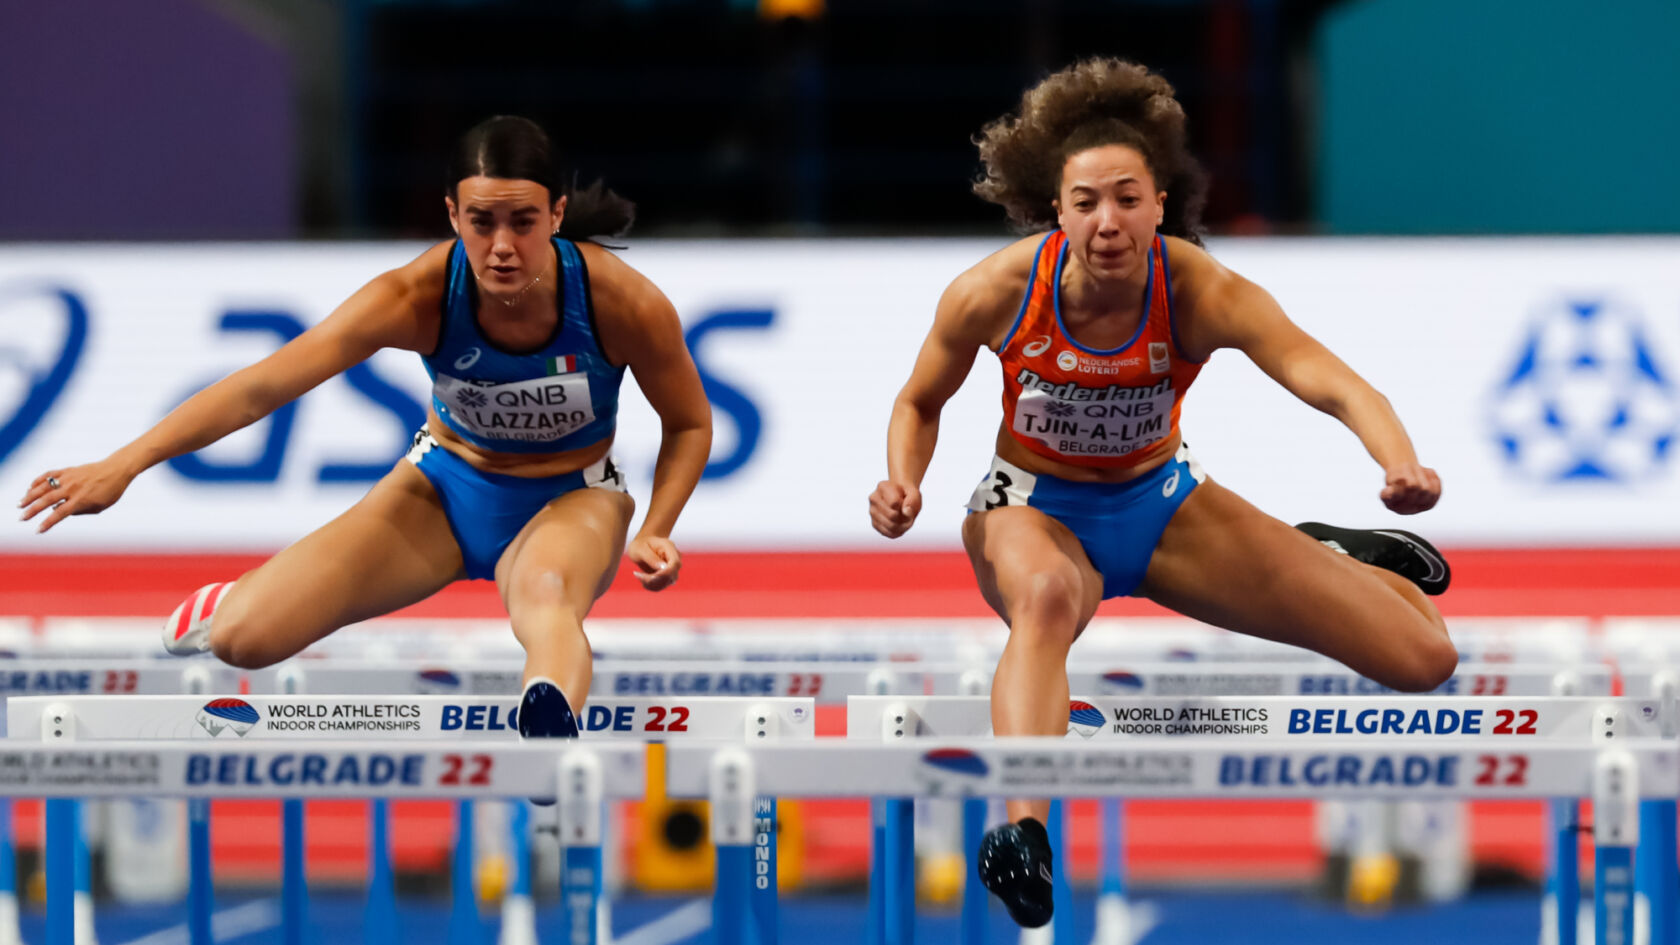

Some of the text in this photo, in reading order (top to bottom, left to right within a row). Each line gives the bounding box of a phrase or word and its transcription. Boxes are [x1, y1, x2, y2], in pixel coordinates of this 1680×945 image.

[1078, 365, 1120, 375] LOTERIJ
[1079, 357, 1140, 367] NEDERLANDSE
[495, 384, 567, 408] QNB
[1084, 402, 1154, 418] QNB
[1023, 413, 1163, 441] TJIN-A-LIM
[985, 471, 1012, 510] 3
[267, 720, 421, 731] INDOOR CHAMPIONSHIPS
[268, 705, 690, 732] WORLD ATHLETICS BELDE 22
[1113, 708, 1539, 735] WORLD ATHLETICS BELGRADE 22
[1113, 724, 1269, 735] INDOOR CHAMPIONSHIPS
[184, 753, 426, 786] BELGRADE
[438, 753, 495, 787] 22
[1218, 754, 1460, 786] BELGRADE
[1474, 754, 1529, 786] 22
[754, 817, 771, 890] MONDO
